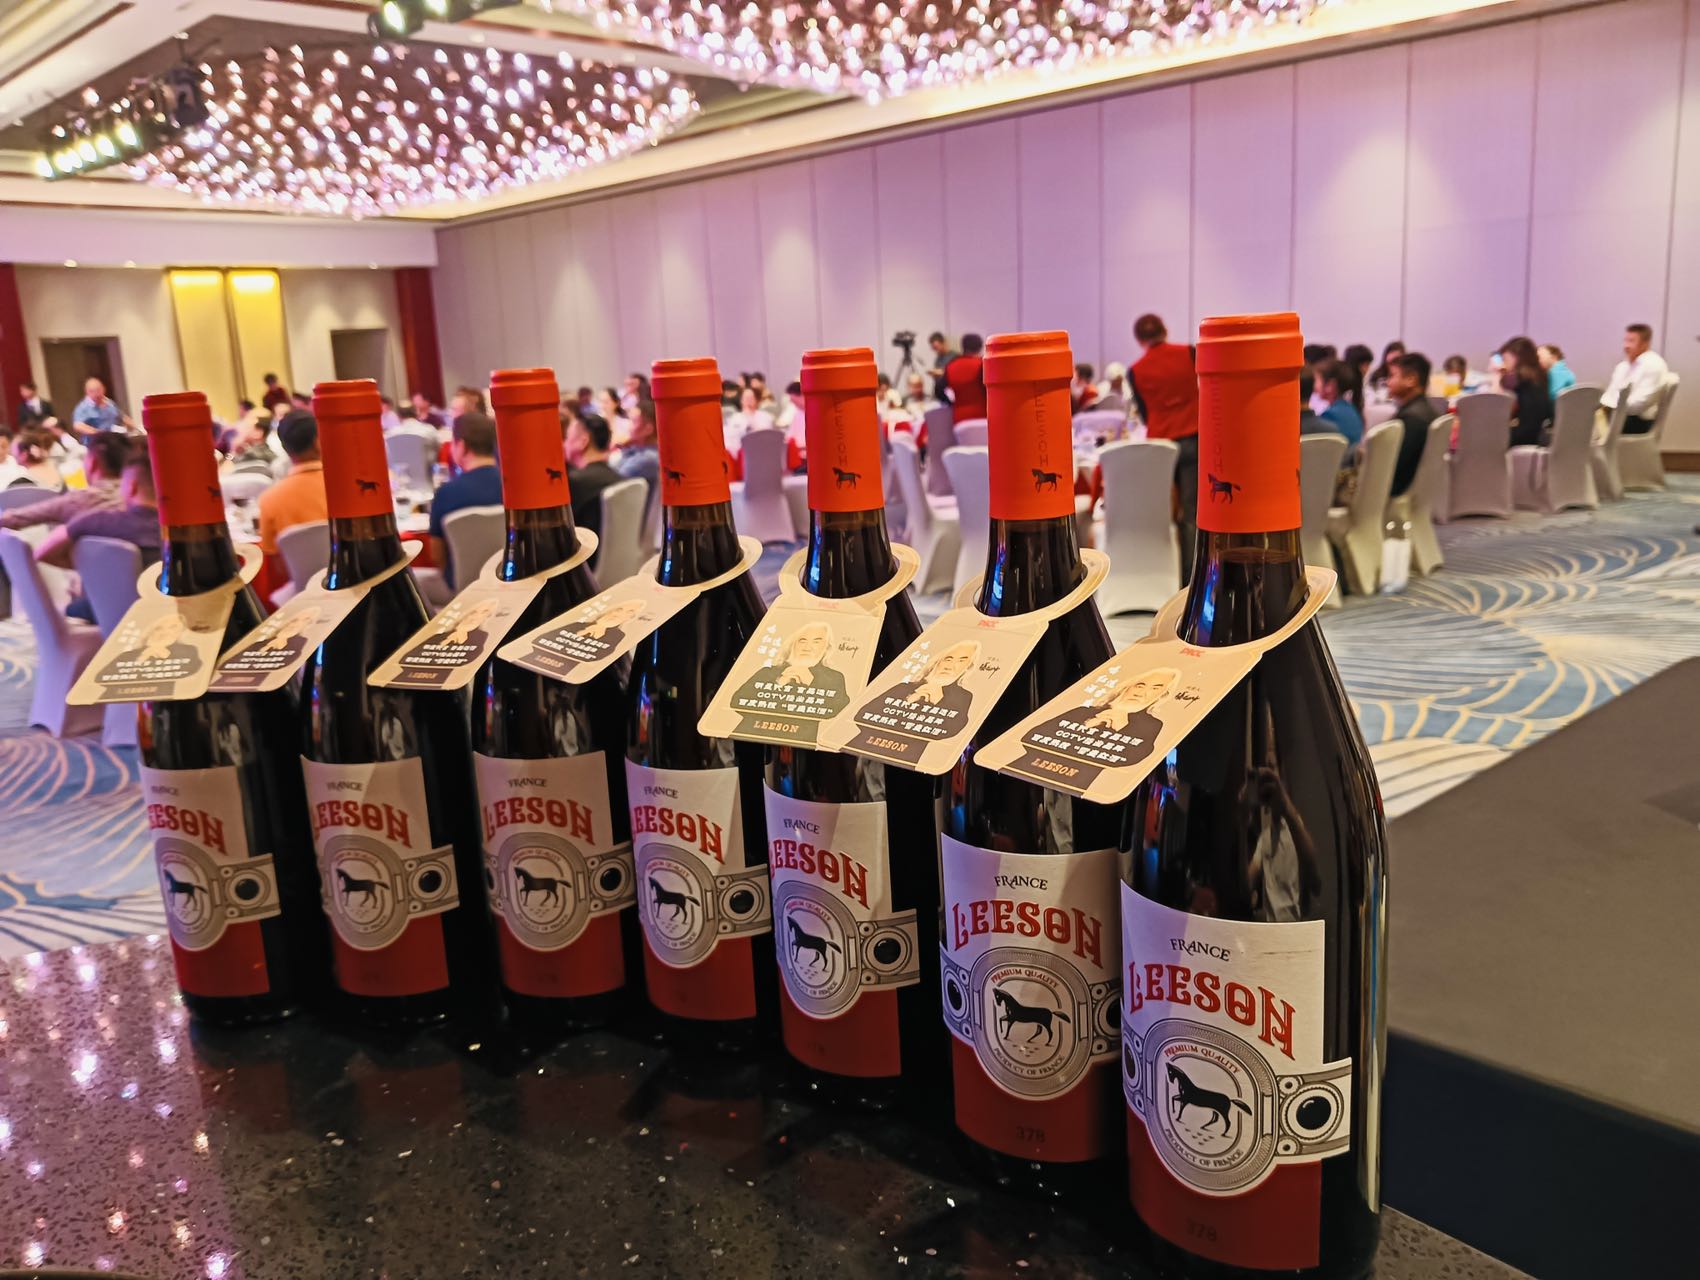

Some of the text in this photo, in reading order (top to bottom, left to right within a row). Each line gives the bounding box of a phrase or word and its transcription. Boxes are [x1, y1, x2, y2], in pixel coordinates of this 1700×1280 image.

[754, 720, 800, 733] LEESON
[866, 736, 908, 752] LEESON
[1031, 757, 1080, 778] LEESON
[326, 781, 362, 792] FRANCE
[508, 777, 547, 788] FRANCE
[643, 785, 679, 799] FRANCE
[147, 803, 228, 857] EESON
[483, 797, 596, 846] LEESON
[783, 818, 821, 835] FRANCE
[632, 805, 726, 865] EESON
[994, 875, 1049, 891] FRANCE
[952, 899, 1104, 969] LEESON
[1169, 938, 1231, 963] FRANCE
[991, 968, 1060, 988] PREMIUM QUALITY
[1128, 961, 1297, 1062] LEESON
[1164, 1044, 1241, 1075] PREMIUM QUALITY
[1026, 1067, 1037, 1076] OF
[1165, 1128, 1244, 1168] PRODUCT OF FRANCE
